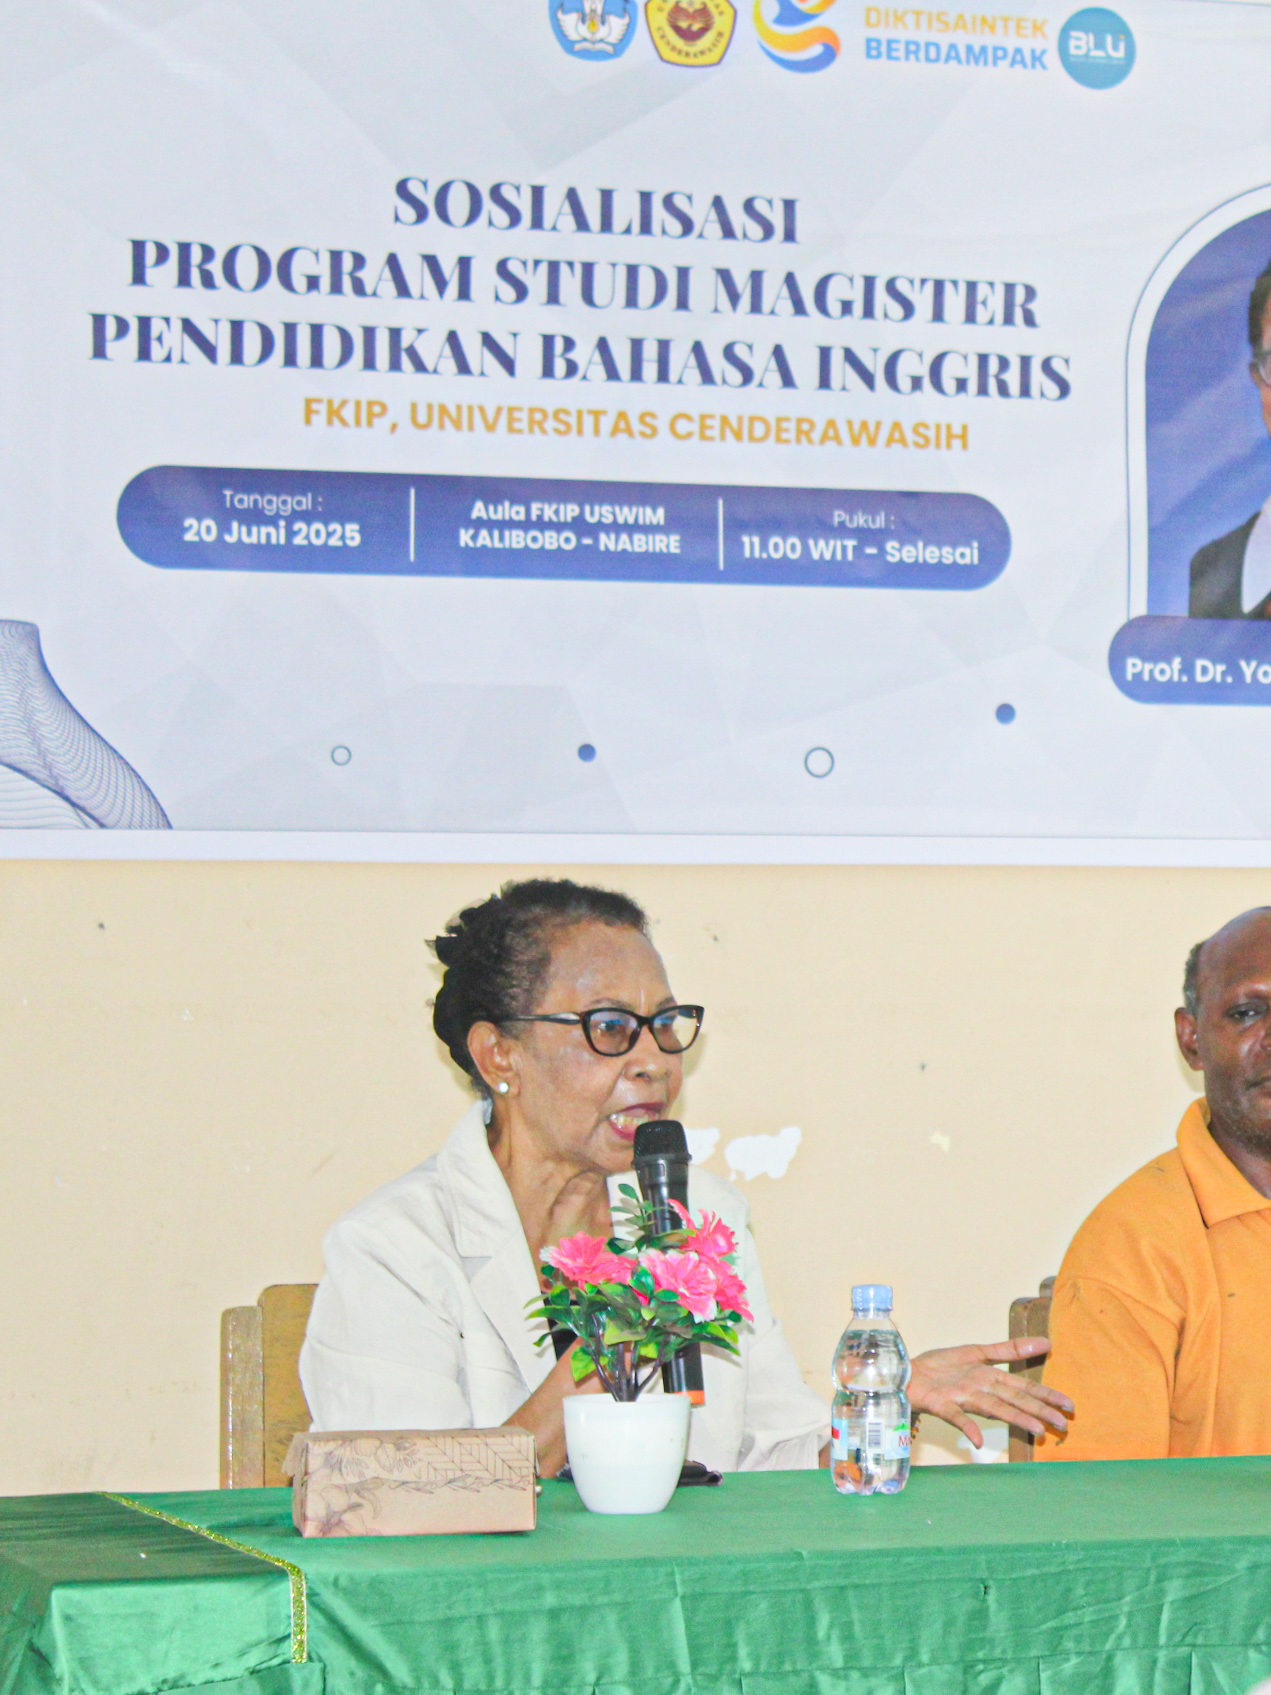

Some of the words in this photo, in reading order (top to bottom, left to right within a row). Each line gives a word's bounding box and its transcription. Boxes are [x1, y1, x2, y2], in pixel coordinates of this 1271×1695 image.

[865, 6, 1046, 38] DIKTISAINTEK
[865, 36, 1048, 71] BERDAMPAK
[1068, 30, 1126, 59] BLU
[393, 176, 798, 245] SOSIALISASI
[129, 238, 474, 303] PROGRAM
[493, 255, 692, 313] STUDI
[711, 266, 1039, 330] MAGISTER
[89, 311, 520, 379] PENDIDIKAN
[539, 332, 798, 390] BAHASA
[816, 344, 1072, 402] INGGRIS
[304, 397, 397, 432] FKIP,
[410, 402, 658, 439] UNIVERSITAS
[669, 412, 968, 450] CENDERAWASIH
[222, 489, 312, 517] Tanggal
[470, 500, 526, 521] Aula
[530, 501, 581, 523] FKIP
[584, 504, 665, 526] USWIM
[183, 517, 218, 543] 20
[223, 519, 286, 545] Juni
[292, 521, 362, 547] 2025
[832, 509, 886, 529] Pukul
[459, 527, 577, 551] KALIBOBO
[598, 532, 681, 554] NABIRE
[741, 534, 802, 560] 11.00
[807, 538, 858, 562] WIT
[885, 540, 979, 565] Selesai
[1125, 656, 1188, 683] Prof.
[1194, 658, 1233, 684] Dr.
